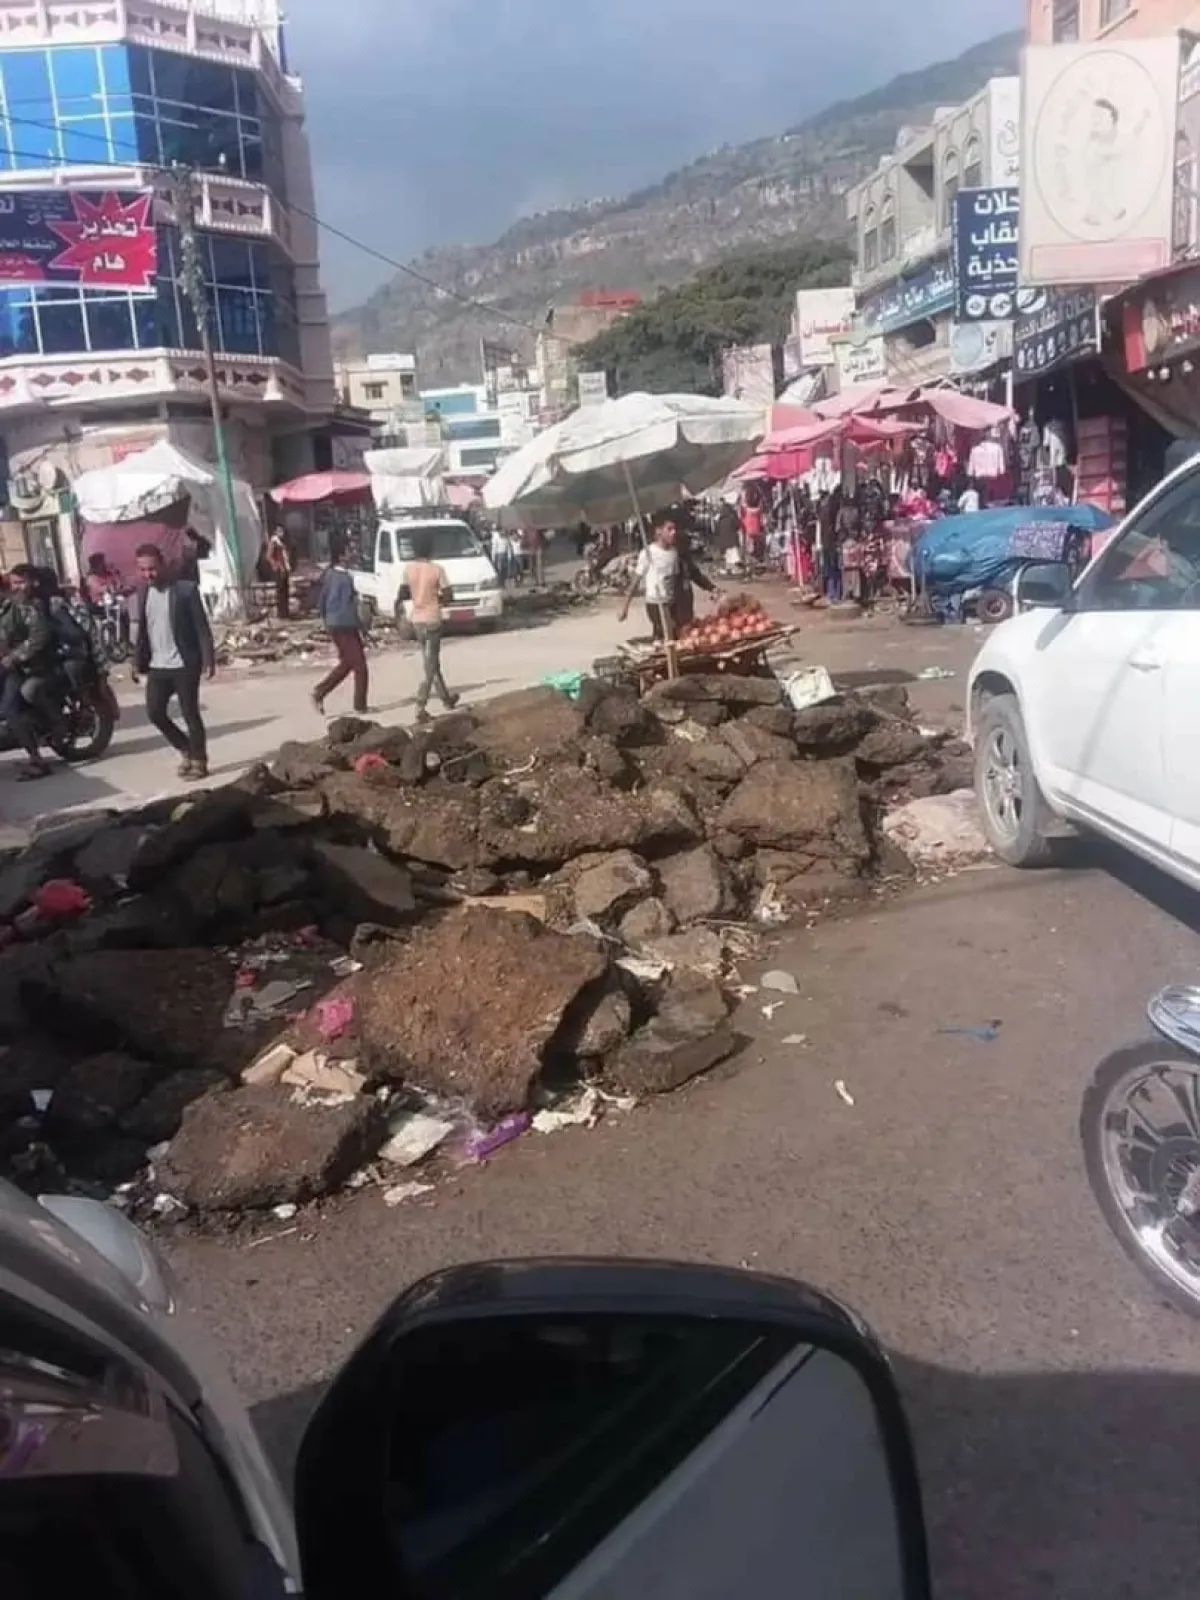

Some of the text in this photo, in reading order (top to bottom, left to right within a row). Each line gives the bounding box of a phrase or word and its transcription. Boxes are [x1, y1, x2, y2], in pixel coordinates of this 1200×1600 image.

[973, 190, 1020, 215] حلات
[79, 214, 138, 241] تحذير
[92, 250, 126, 273] هام
[968, 252, 1019, 281] حذية
